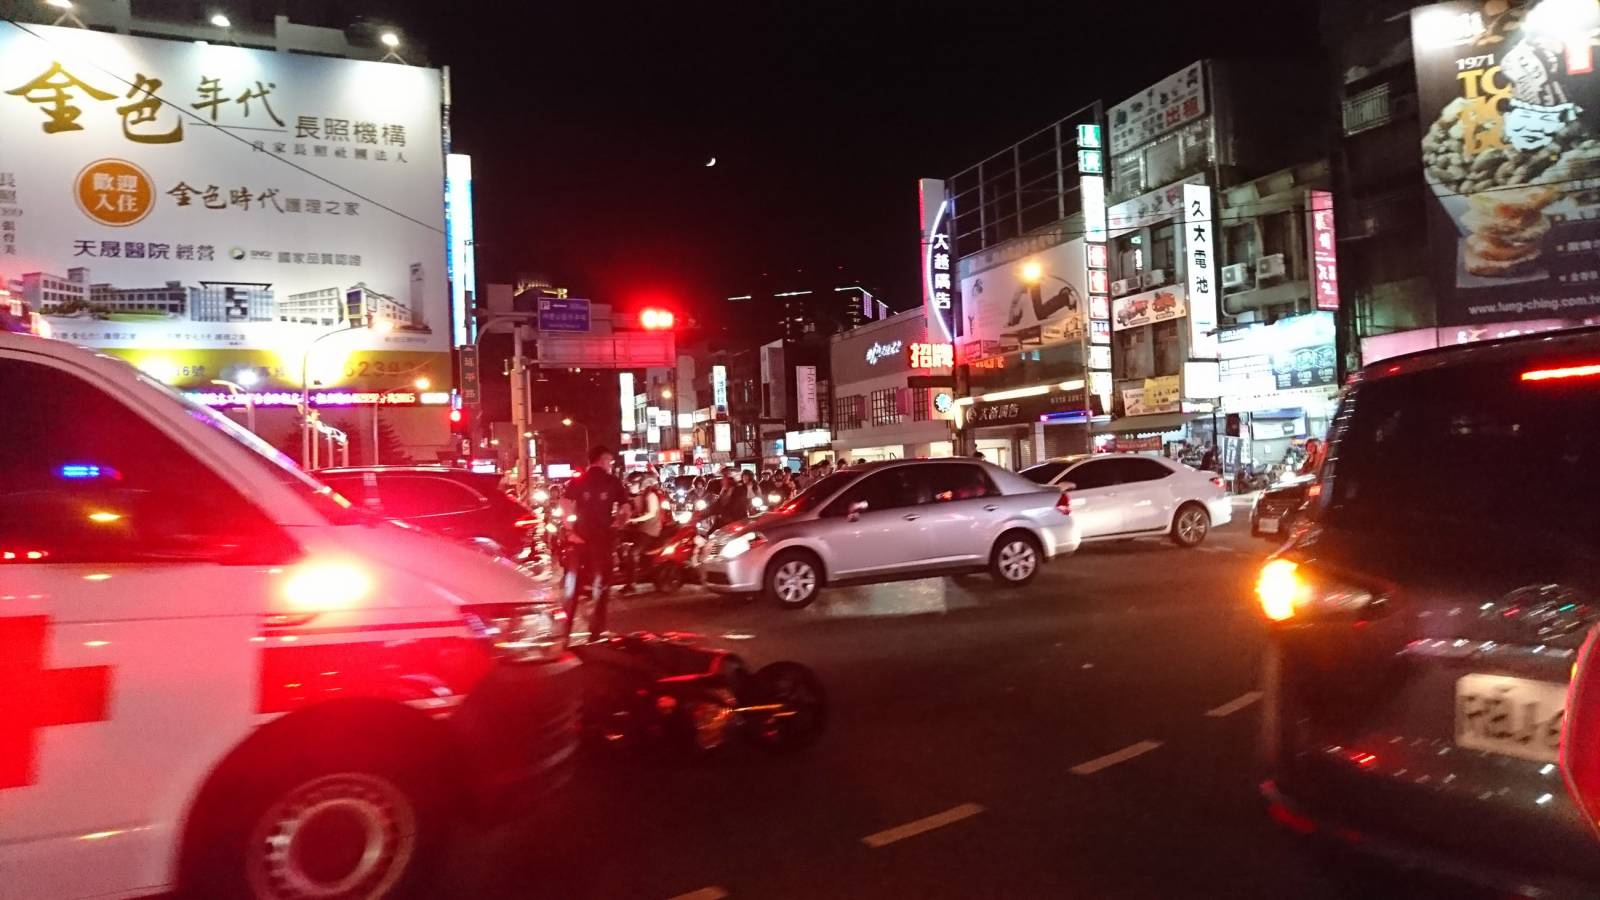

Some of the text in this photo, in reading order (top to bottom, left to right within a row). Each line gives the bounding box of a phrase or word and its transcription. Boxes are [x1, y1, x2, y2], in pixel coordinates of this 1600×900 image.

[1456, 53, 1495, 70] 1971
[294, 115, 407, 147] 長照機構
[92, 172, 139, 192] 歡迎
[94, 192, 140, 212] 入住
[73, 239, 171, 260] 天晟醫院
[1190, 199, 1209, 294] 久大電池
[909, 342, 955, 369] 招牌
